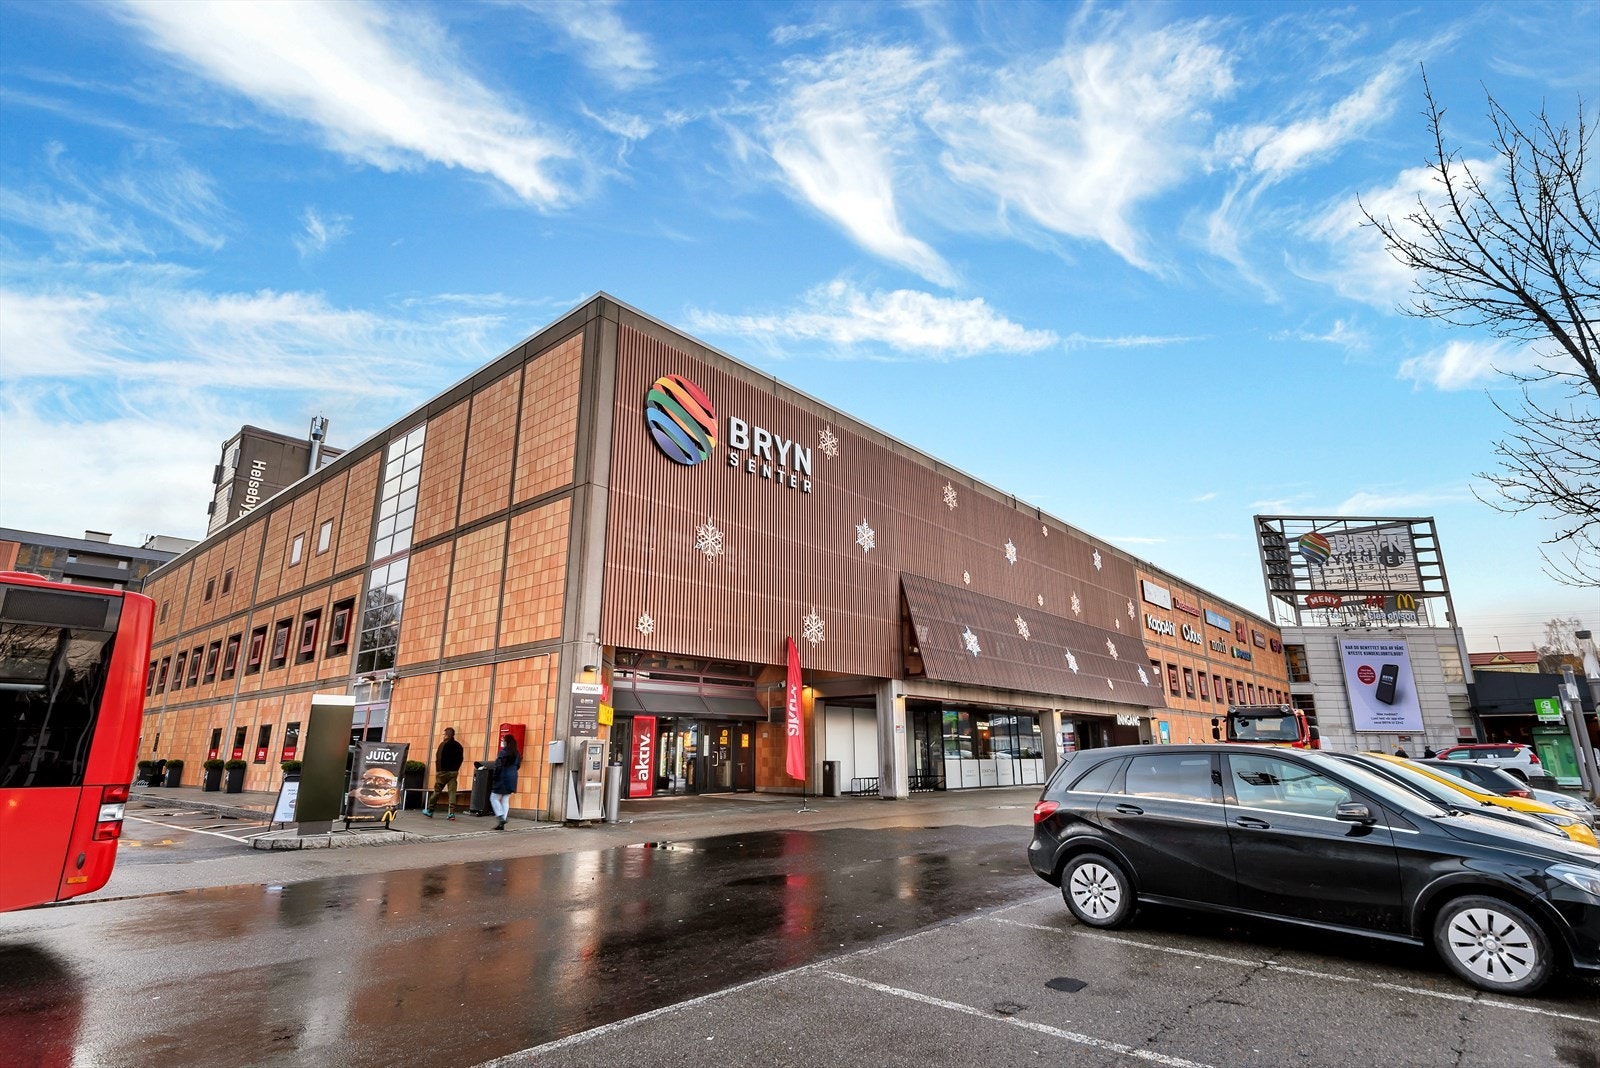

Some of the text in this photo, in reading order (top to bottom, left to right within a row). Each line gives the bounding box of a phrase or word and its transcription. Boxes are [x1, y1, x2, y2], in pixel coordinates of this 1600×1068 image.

[728, 416, 812, 476] BRYN
[728, 452, 812, 494] SENTER
[1334, 534, 1403, 554] BRYN
[1339, 555, 1406, 565] SENTER
[1310, 595, 1338, 605] MENY
[1368, 610, 1416, 621] clas ohlson
[1146, 613, 1176, 637] KappAhl
[1117, 713, 1140, 726] INNGANG
[365, 750, 399, 761] JUICY
[635, 733, 651, 781] aktiv.
